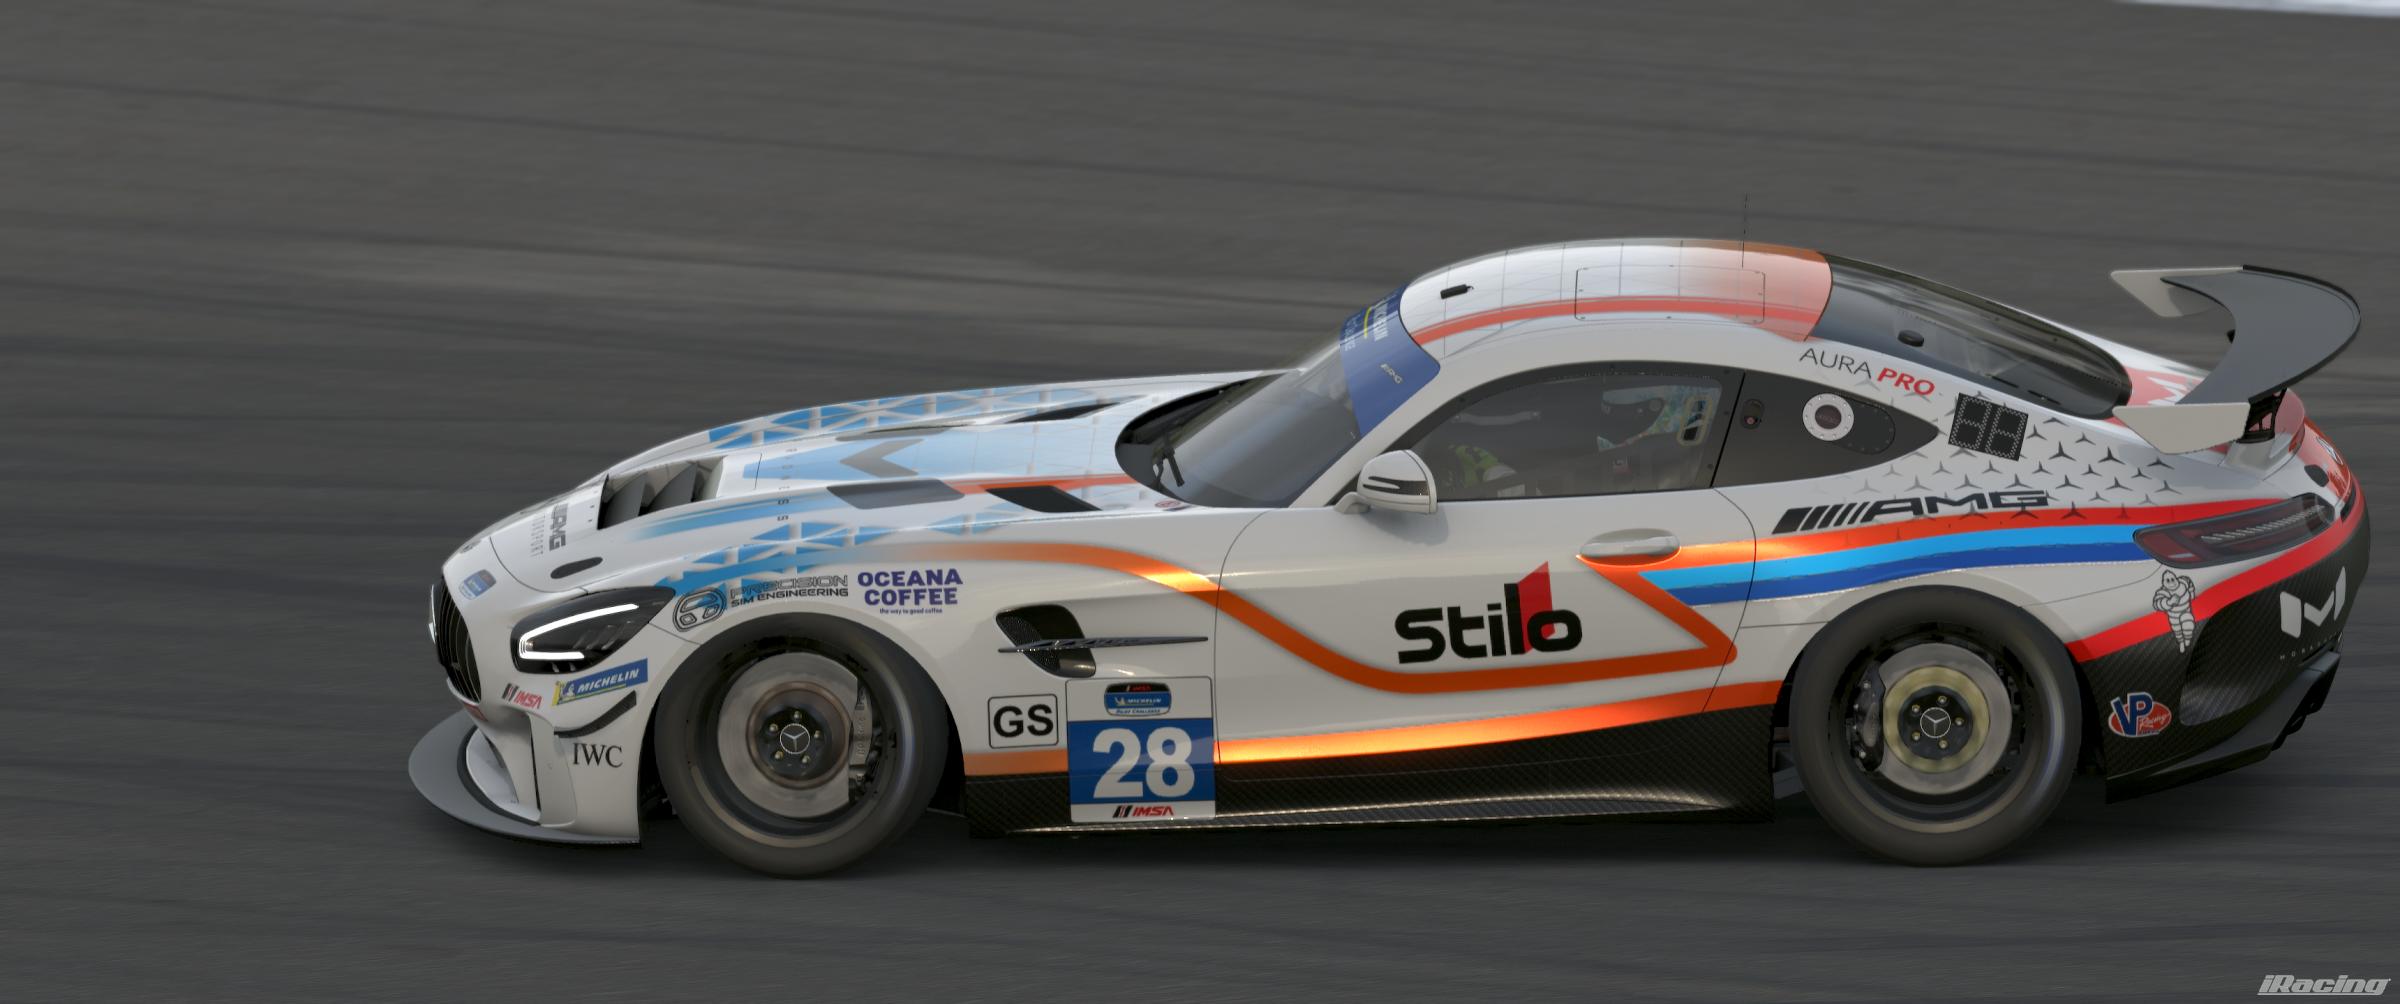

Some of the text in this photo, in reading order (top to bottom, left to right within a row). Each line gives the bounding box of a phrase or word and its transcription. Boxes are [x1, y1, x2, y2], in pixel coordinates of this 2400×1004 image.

[1799, 348, 1936, 396] AURA PRO
[1860, 490, 2049, 524] AMG
[729, 575, 848, 600] PRECISION
[857, 568, 963, 587] OCEANA
[730, 586, 849, 608] SIM ENGINEERING
[864, 587, 958, 606] COFFEE
[1394, 575, 1583, 664] Stilo
[577, 668, 640, 694] MICHELIN
[513, 689, 543, 709] IMSA
[993, 704, 1054, 738] GS
[2110, 691, 2153, 737] VP
[573, 743, 623, 768] IWC
[1092, 726, 1195, 799] 28
[1132, 806, 1174, 817] IMSA
